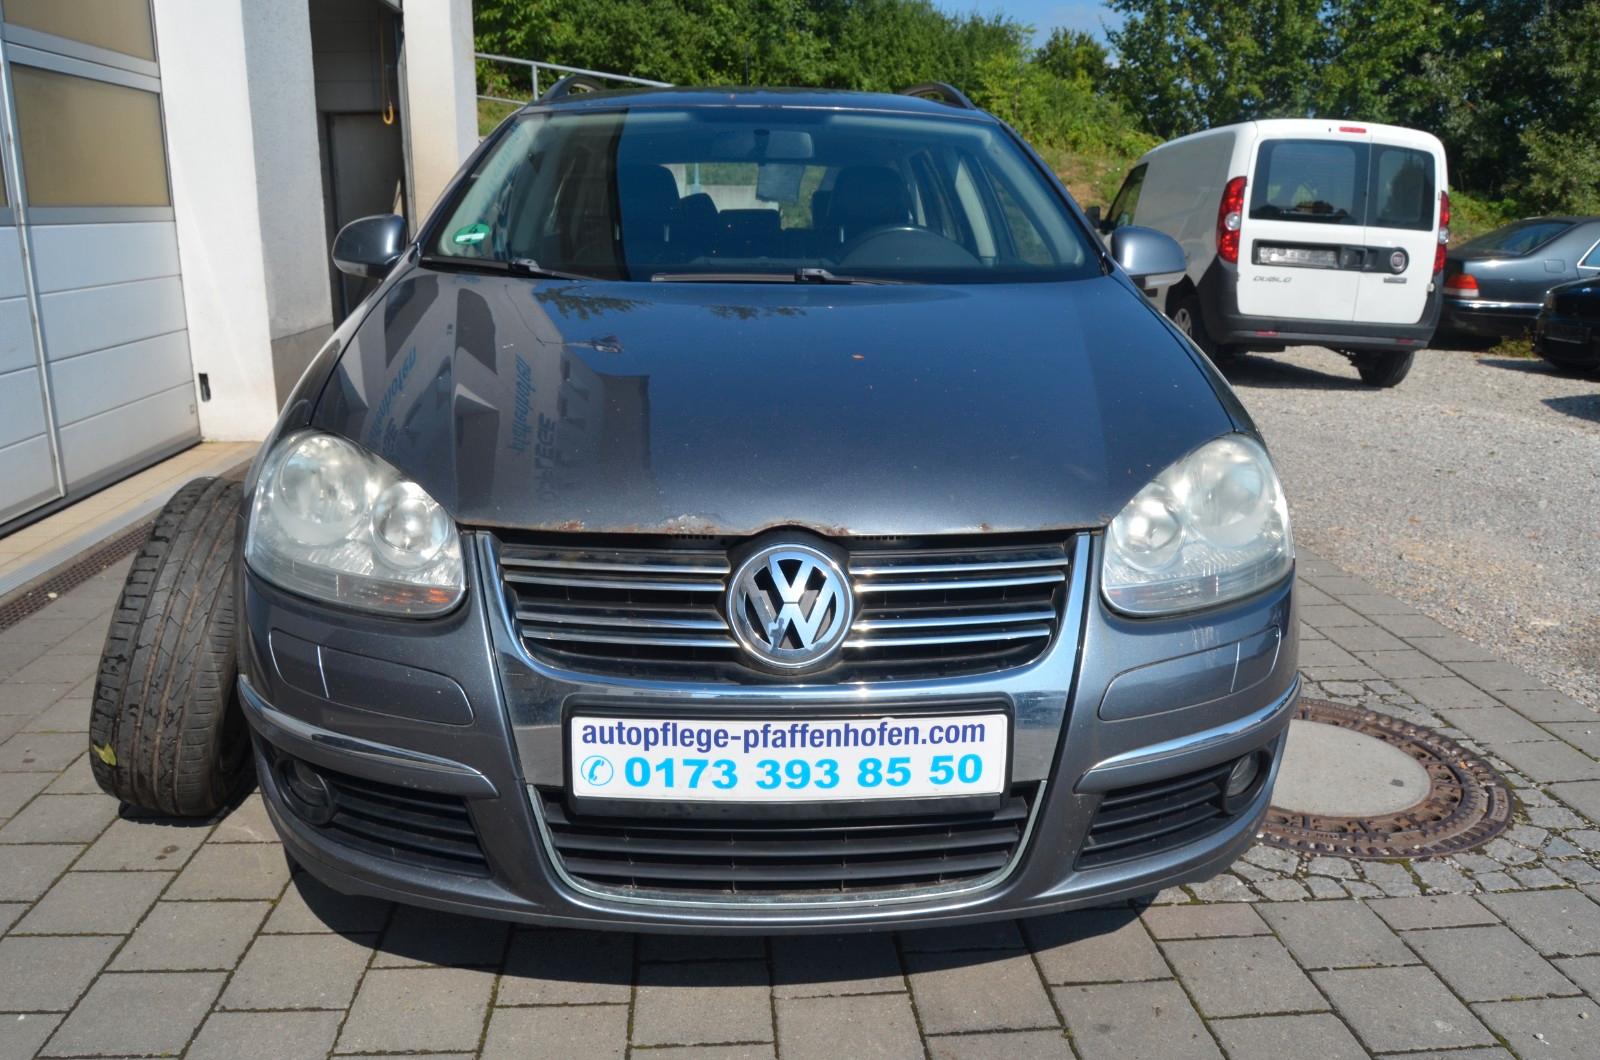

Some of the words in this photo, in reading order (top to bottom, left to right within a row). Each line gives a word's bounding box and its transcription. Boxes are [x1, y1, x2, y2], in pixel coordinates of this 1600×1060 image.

[582, 722, 985, 753] autopflege-pfaffenhofen.com
[625, 757, 738, 789] 0173
[756, 758, 840, 789] 393
[857, 757, 911, 788] 85
[928, 754, 983, 785] 50
